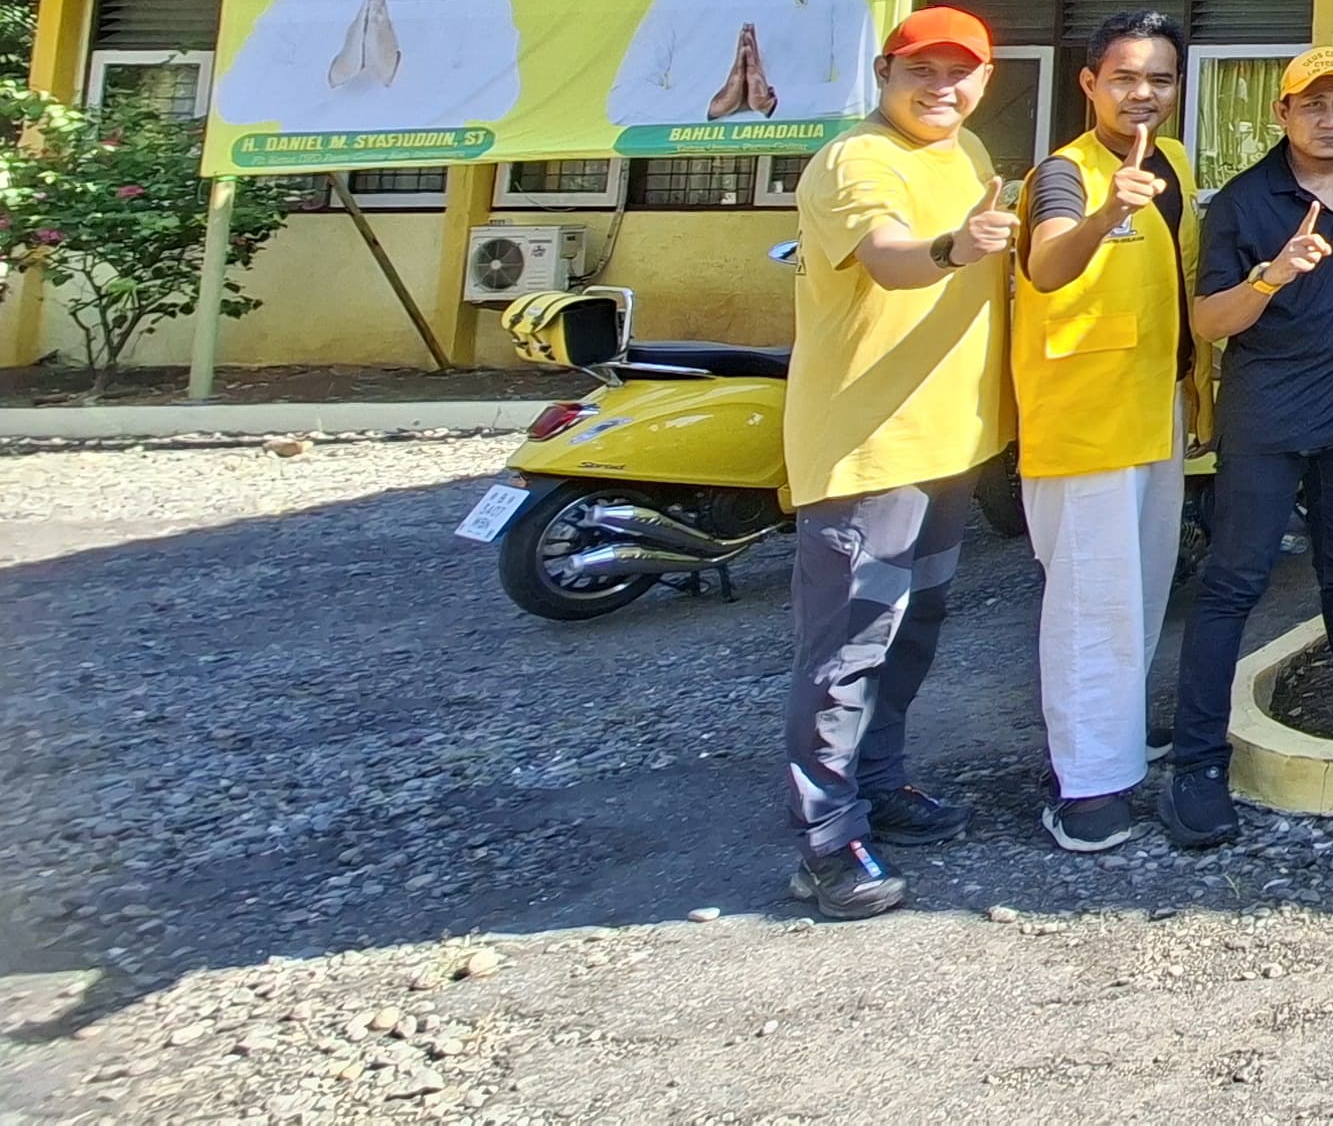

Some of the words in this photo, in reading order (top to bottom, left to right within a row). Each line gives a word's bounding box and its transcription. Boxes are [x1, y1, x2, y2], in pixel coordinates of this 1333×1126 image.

[240, 137, 258, 153] H.
[265, 135, 324, 152] DANIEL
[328, 133, 349, 150] M.
[463, 129, 488, 146] ST
[668, 127, 726, 141] BAHLIL
[731, 123, 825, 140] LAHADALIA
